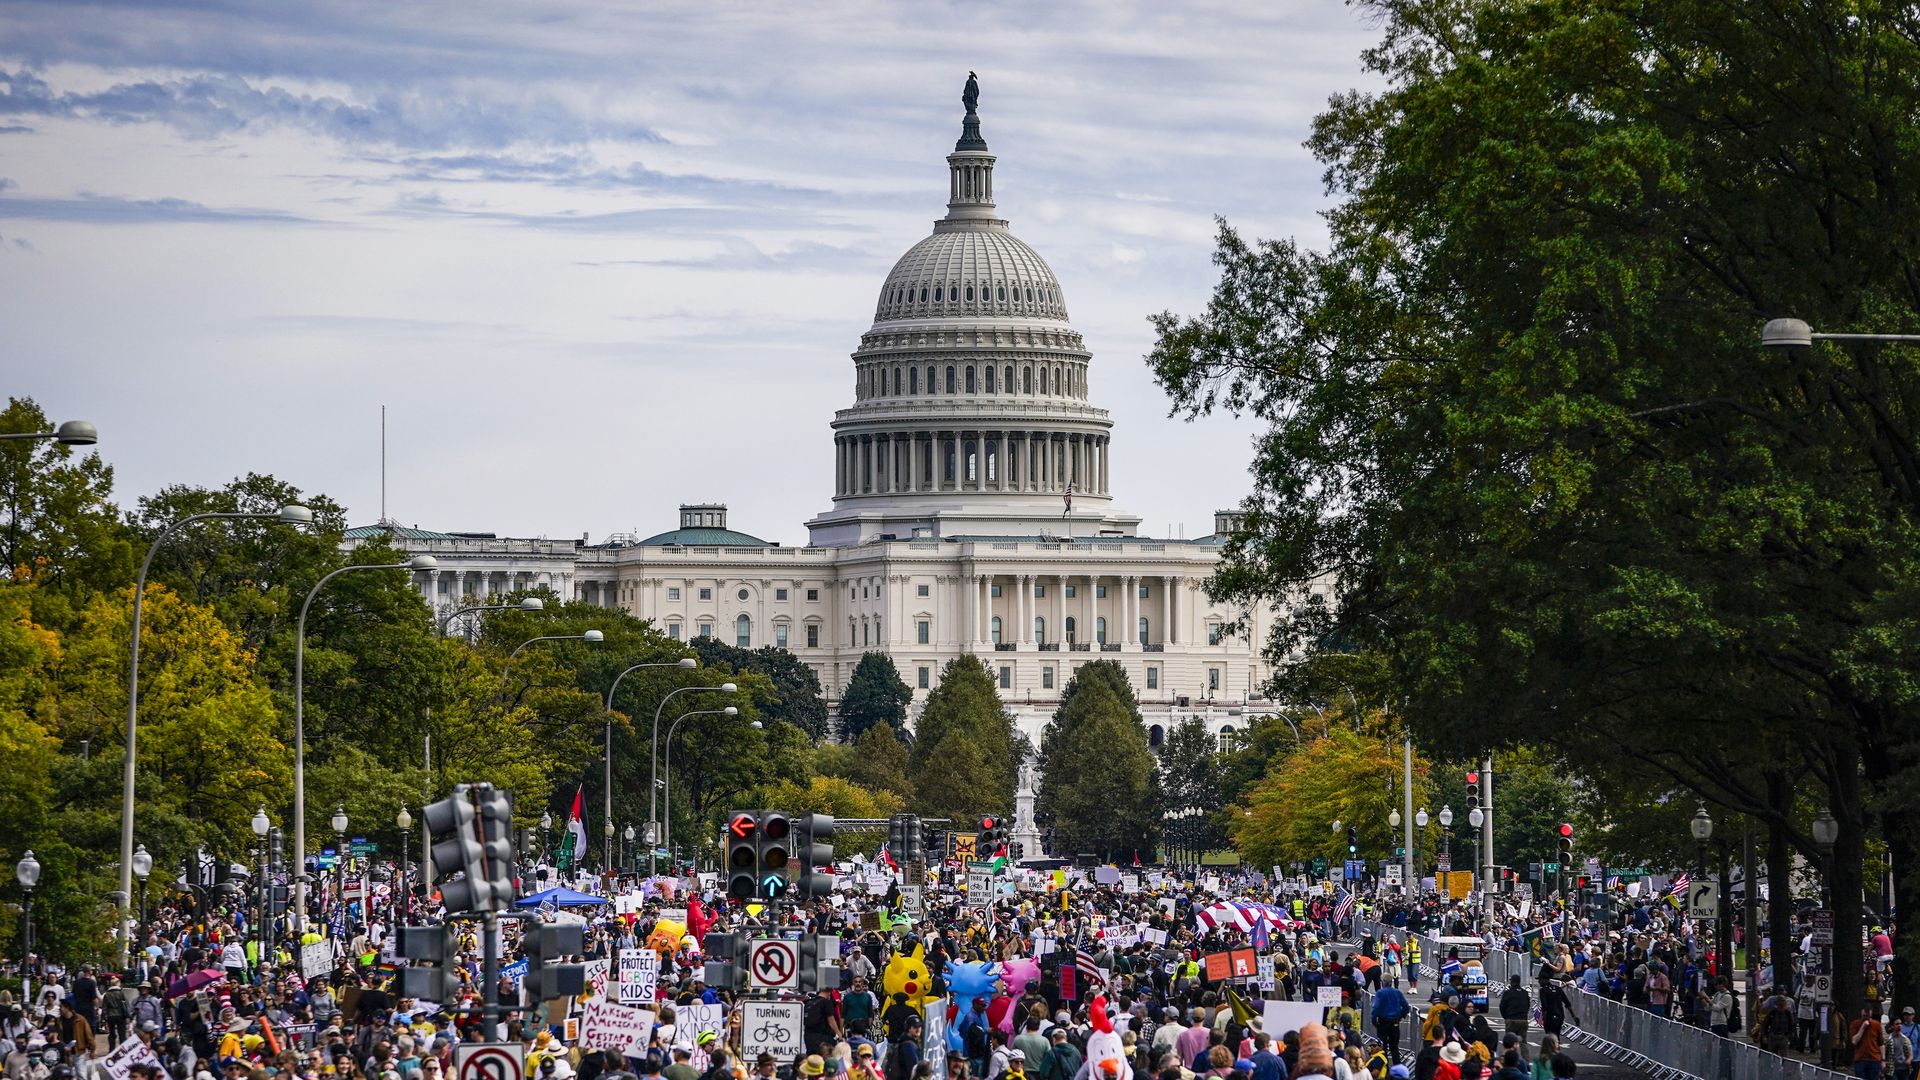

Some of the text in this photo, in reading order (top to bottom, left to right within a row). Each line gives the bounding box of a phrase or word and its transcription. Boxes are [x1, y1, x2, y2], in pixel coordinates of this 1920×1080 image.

[1105, 929, 1119, 938] NO
[502, 963, 528, 977] DEPORT
[588, 960, 607, 978] ICE
[621, 958, 654, 970] PROTECT
[590, 969, 609, 989] OUT
[621, 972, 654, 983] LGBTQ
[621, 985, 654, 999] KIDS
[587, 1002, 634, 1020] MAKING
[687, 1006, 711, 1022] NO
[756, 1008, 791, 1019] TURNING
[586, 1016, 645, 1030] AMERICANS
[586, 1028, 633, 1043] GESTAPO
[744, 1046, 799, 1055] USE X-WALKS
